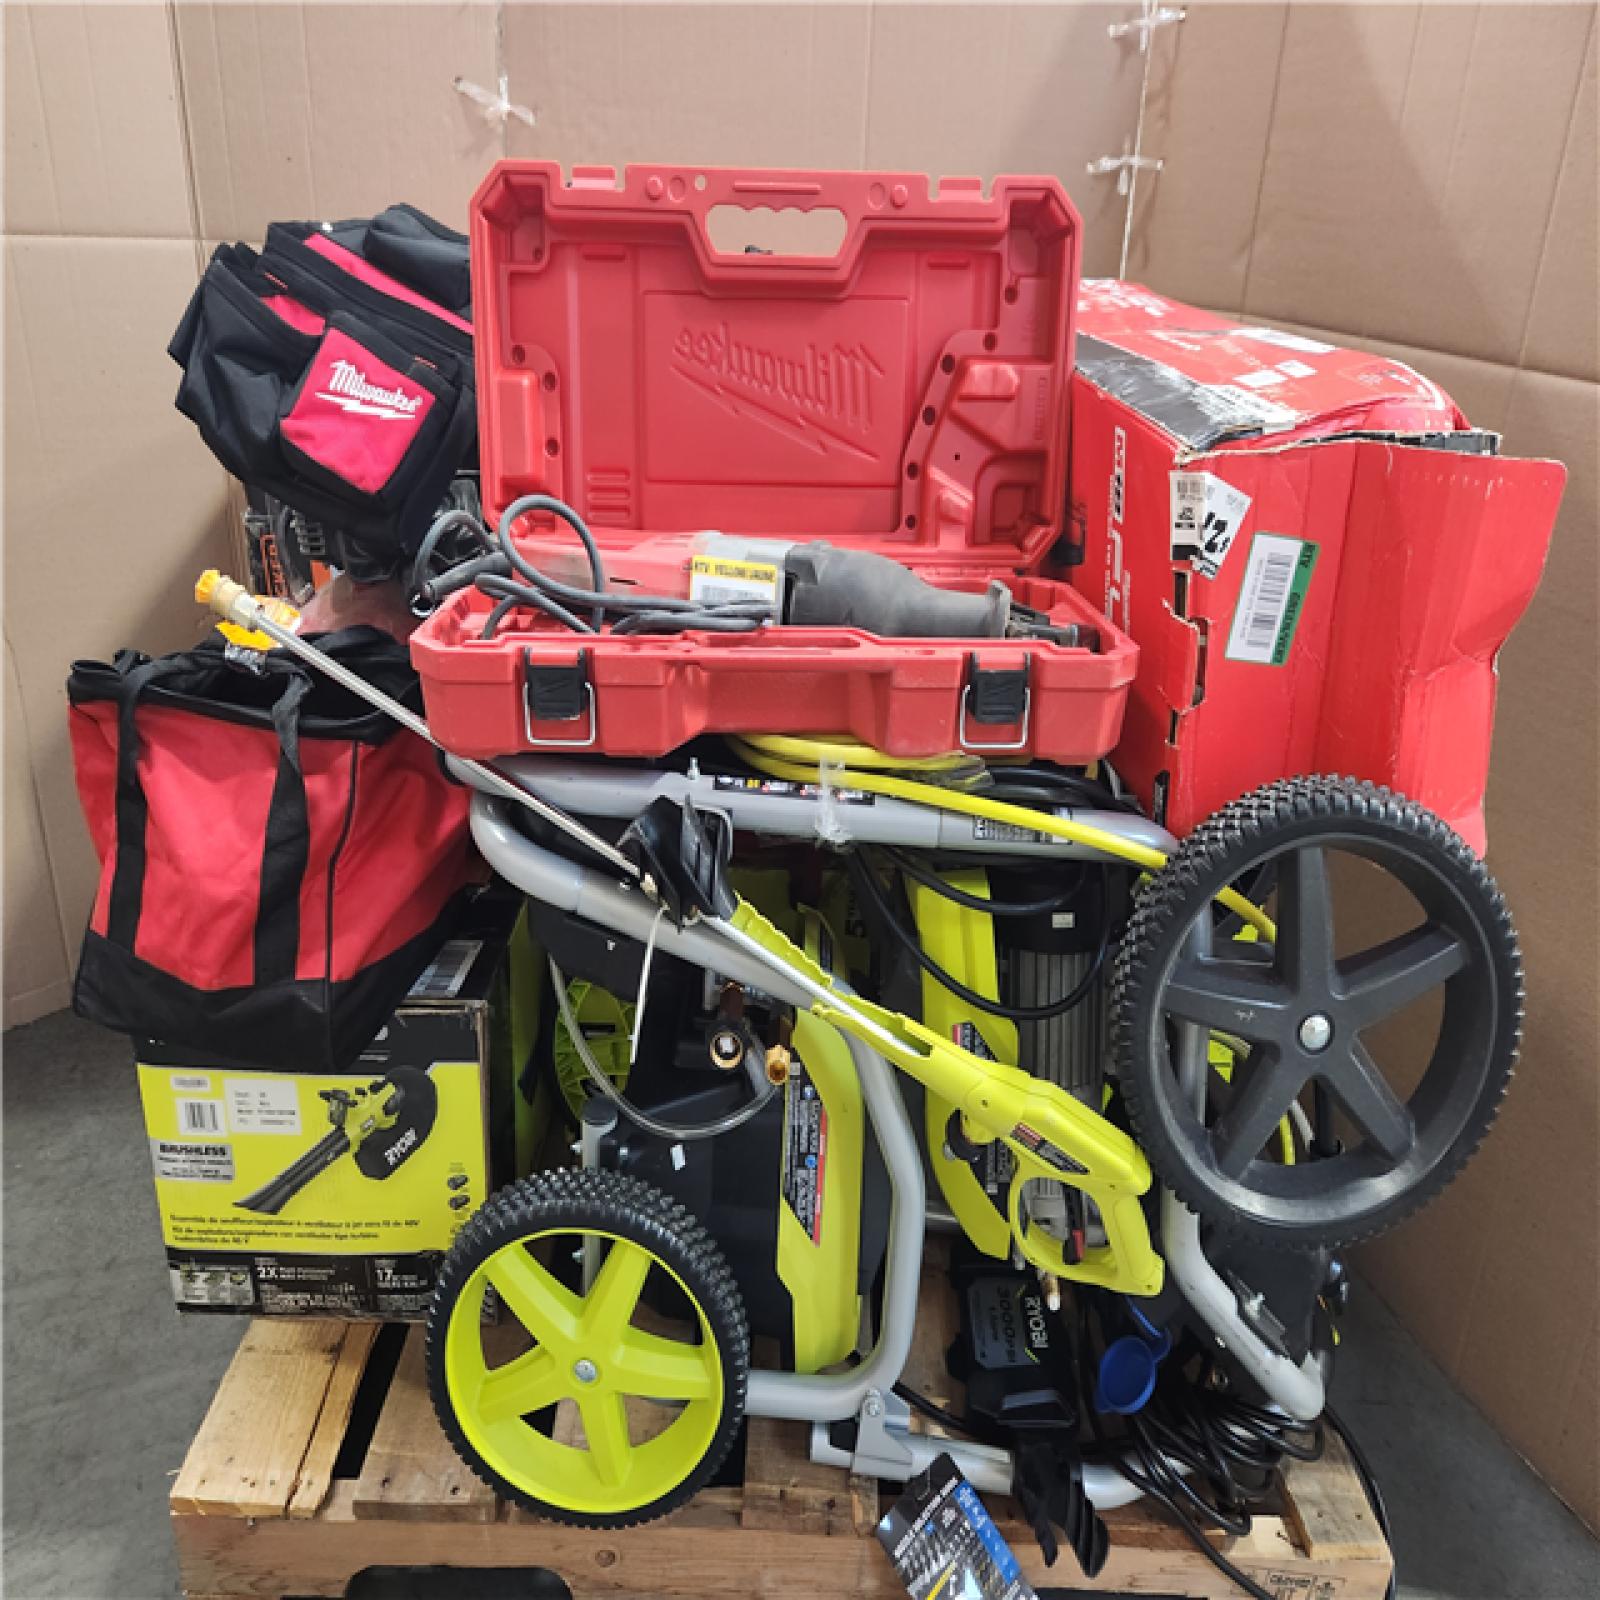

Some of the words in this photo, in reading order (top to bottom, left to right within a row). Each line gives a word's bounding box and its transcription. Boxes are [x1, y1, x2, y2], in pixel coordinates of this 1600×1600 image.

[329, 360, 416, 412] Milwaukee
[1299, 544, 1316, 569] RTV
[159, 1144, 226, 1156] BRUSHLESS
[385, 1127, 417, 1166] RYOBI
[1025, 1297, 1048, 1348] RYOBI
